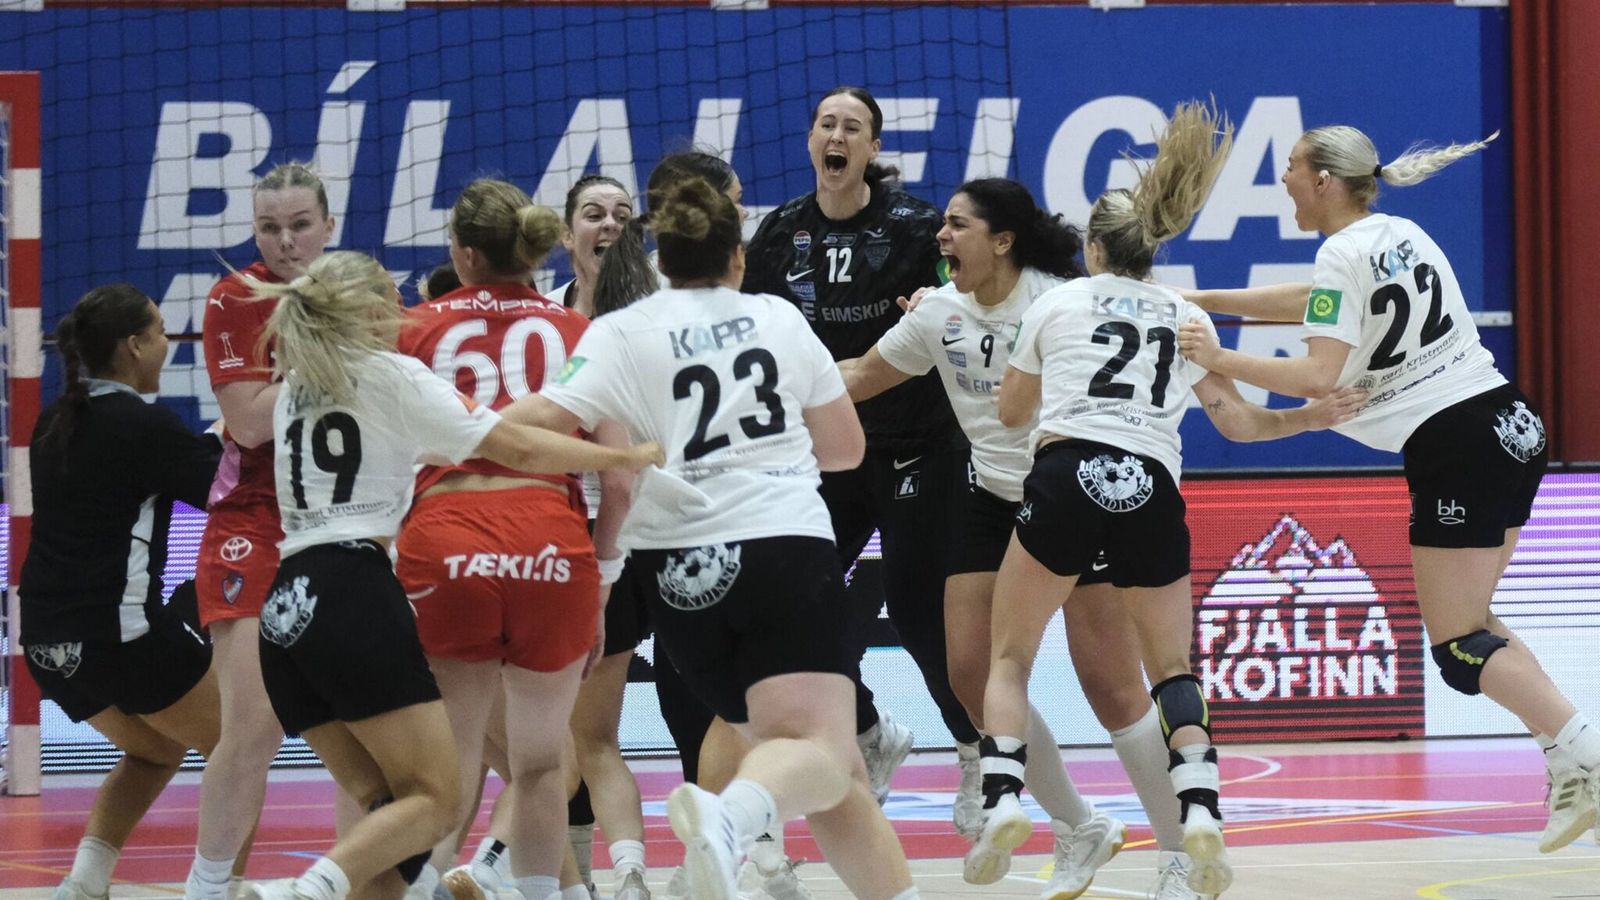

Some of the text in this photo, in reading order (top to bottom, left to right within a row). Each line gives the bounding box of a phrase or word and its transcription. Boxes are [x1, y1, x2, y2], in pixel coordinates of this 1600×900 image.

[826, 247, 852, 283] 12
[429, 298, 567, 313] TEMPRA
[821, 300, 890, 322] EIMSKIP
[1366, 262, 1454, 371] 22
[669, 316, 756, 358] KAPP
[981, 334, 994, 368] 9
[432, 316, 568, 409] 60
[1088, 321, 1176, 409] 21
[673, 347, 786, 461] 23
[285, 411, 362, 510] 19
[1082, 476, 1147, 509] LUNDINN
[1438, 499, 1465, 516] bh
[444, 551, 571, 583] TÆKI.IS
[1199, 606, 1397, 653] FJALLA
[1200, 654, 1396, 701] KOFINN
